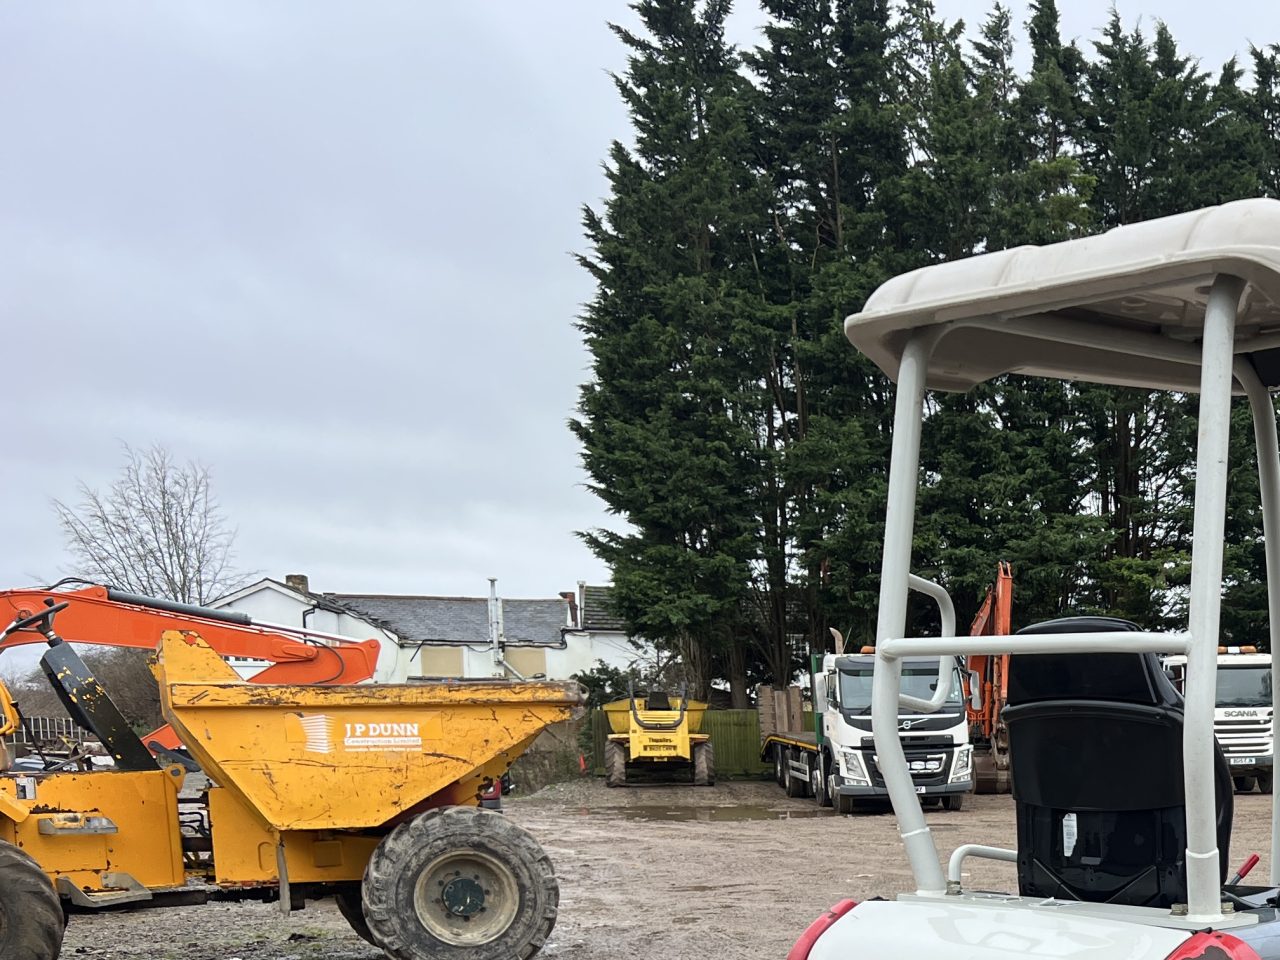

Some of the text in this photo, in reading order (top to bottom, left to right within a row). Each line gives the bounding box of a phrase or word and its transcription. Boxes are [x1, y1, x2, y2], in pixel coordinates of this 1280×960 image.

[345, 723, 419, 737] J P DUNN
